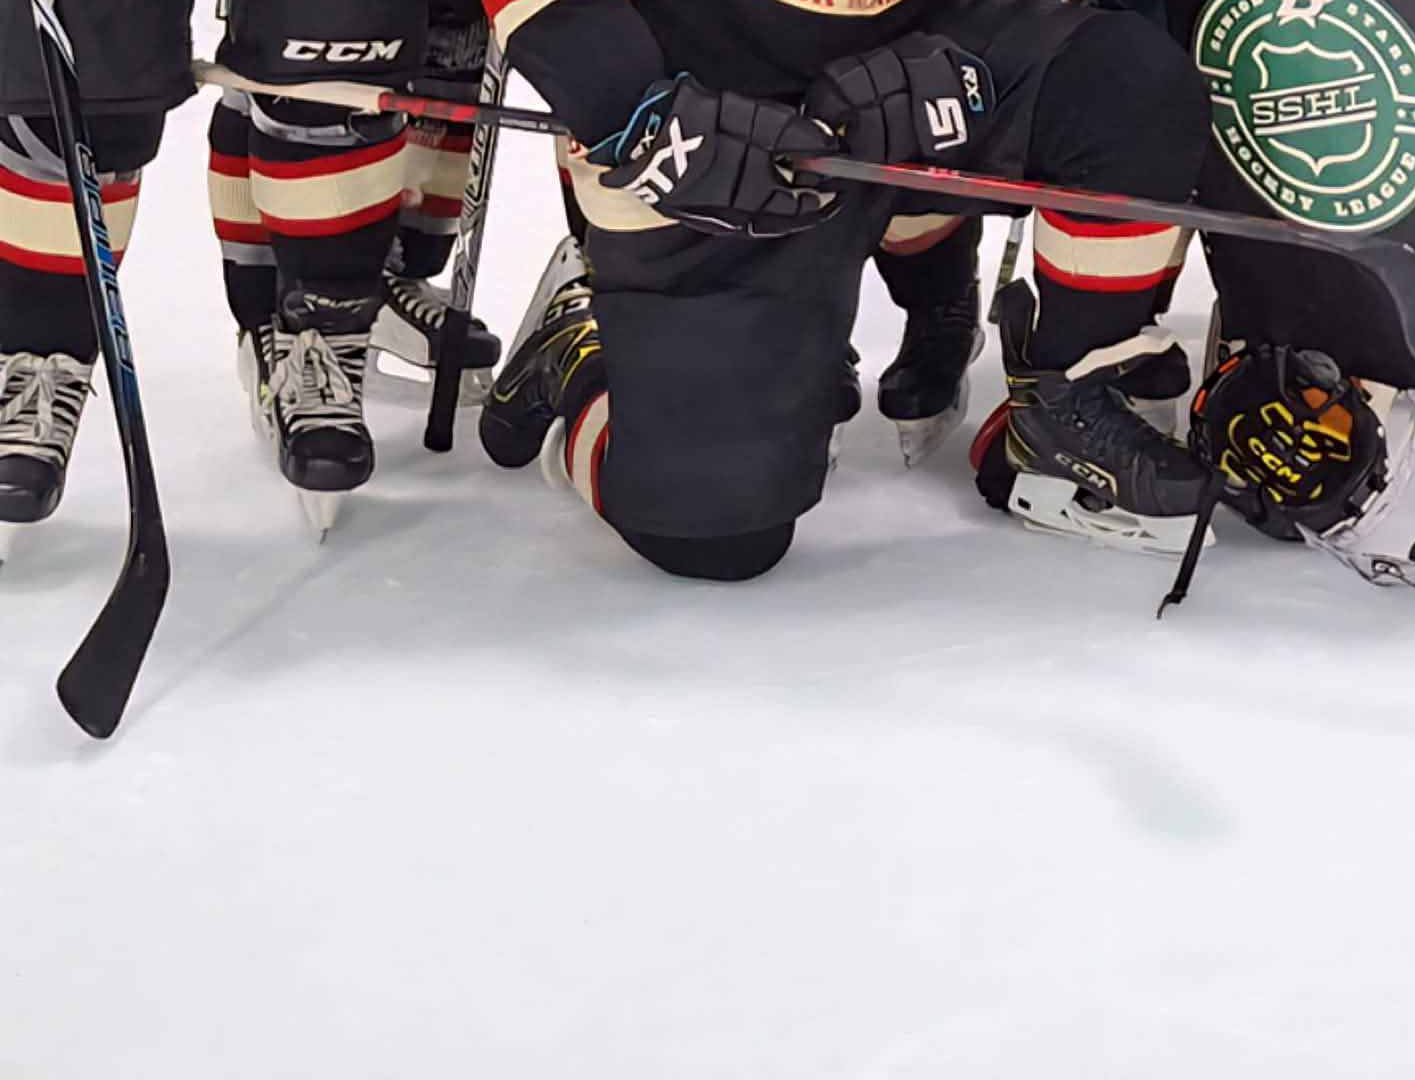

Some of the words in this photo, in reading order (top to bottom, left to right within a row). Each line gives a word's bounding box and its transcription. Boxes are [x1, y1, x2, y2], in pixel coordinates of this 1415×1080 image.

[282, 39, 403, 63] CCM
[1346, 2, 1413, 77] STARS
[1252, 86, 1377, 125] SSHL
[1225, 126, 1315, 212] HOCKEY
[1054, 452, 1107, 489] CCM
[1247, 436, 1302, 484] CCM
